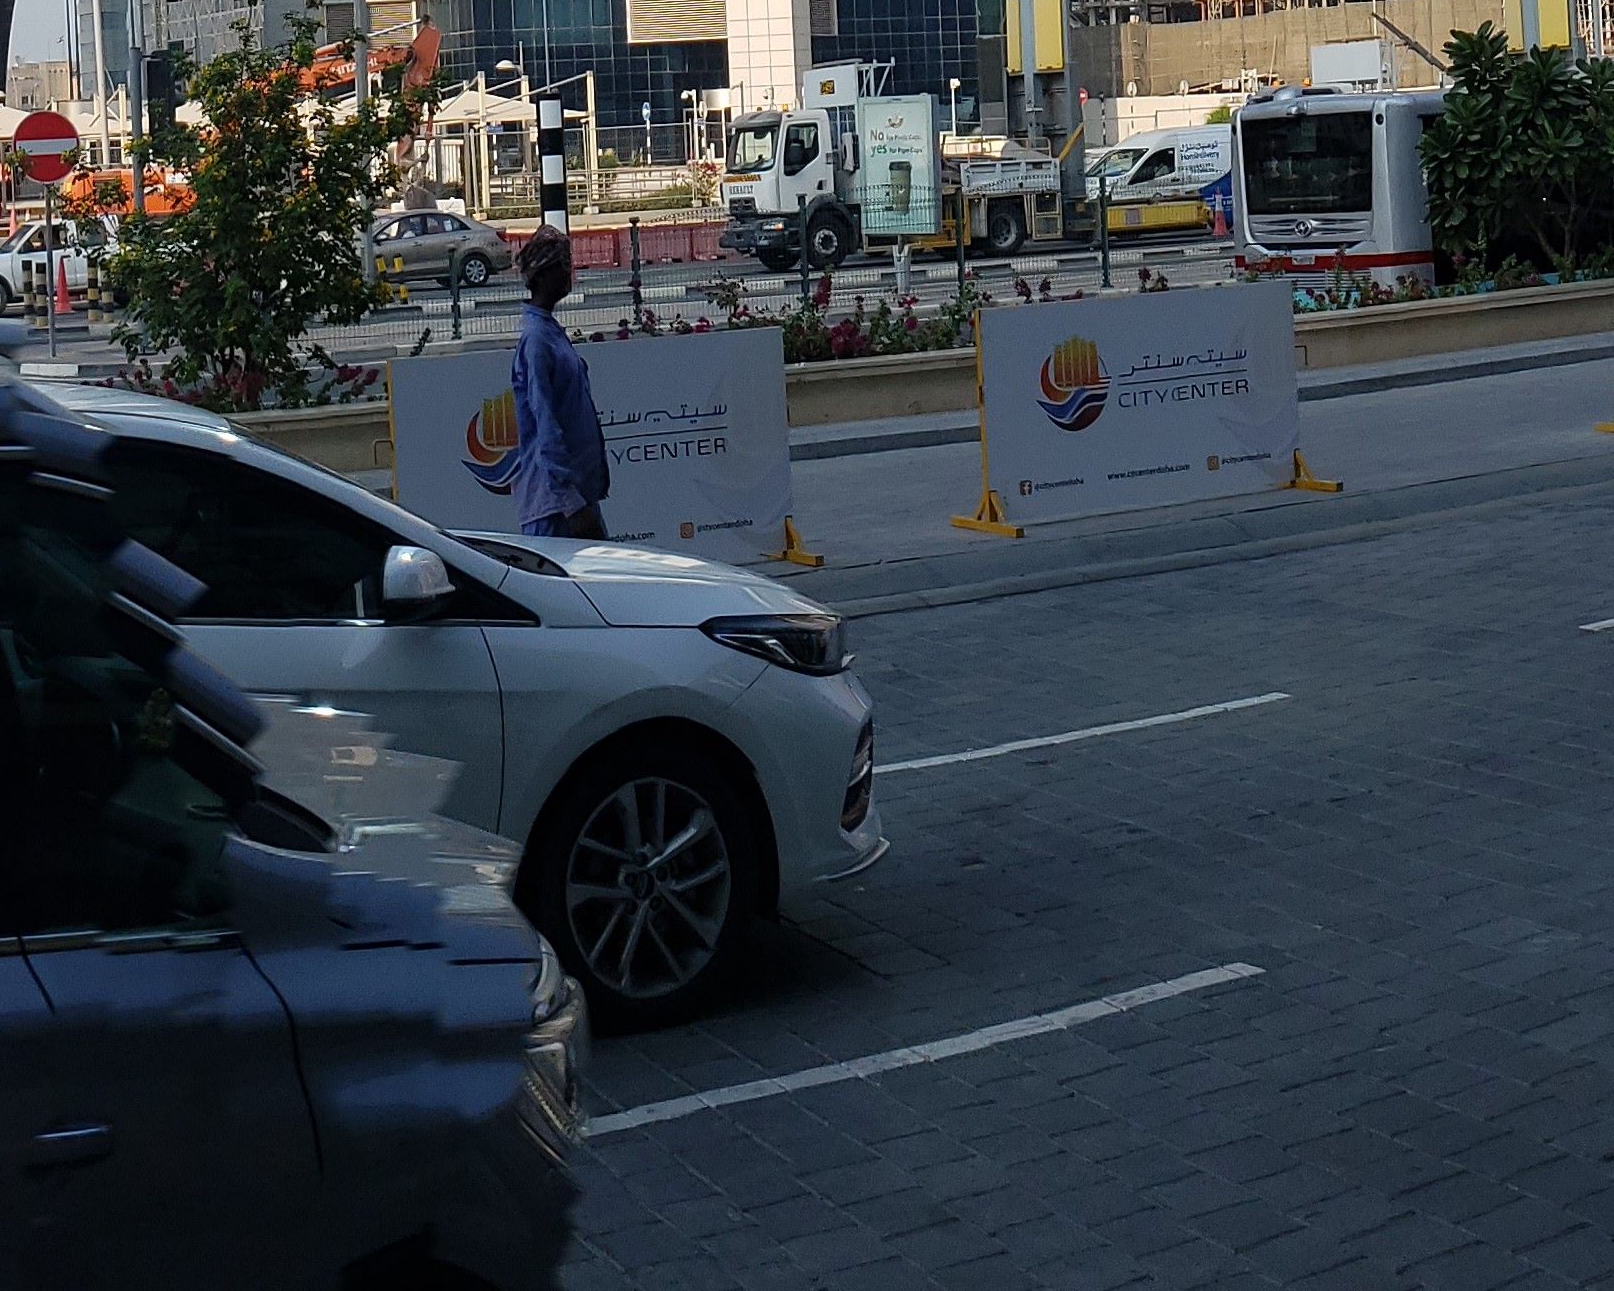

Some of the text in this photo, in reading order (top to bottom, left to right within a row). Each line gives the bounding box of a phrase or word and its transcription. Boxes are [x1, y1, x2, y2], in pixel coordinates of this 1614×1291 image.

[330, 57, 378, 76] HITAHI
[870, 130, 884, 141] No
[870, 144, 887, 157] yes
[1117, 388, 1168, 408] CITY
[596, 404, 728, 427] سيتي سنت
